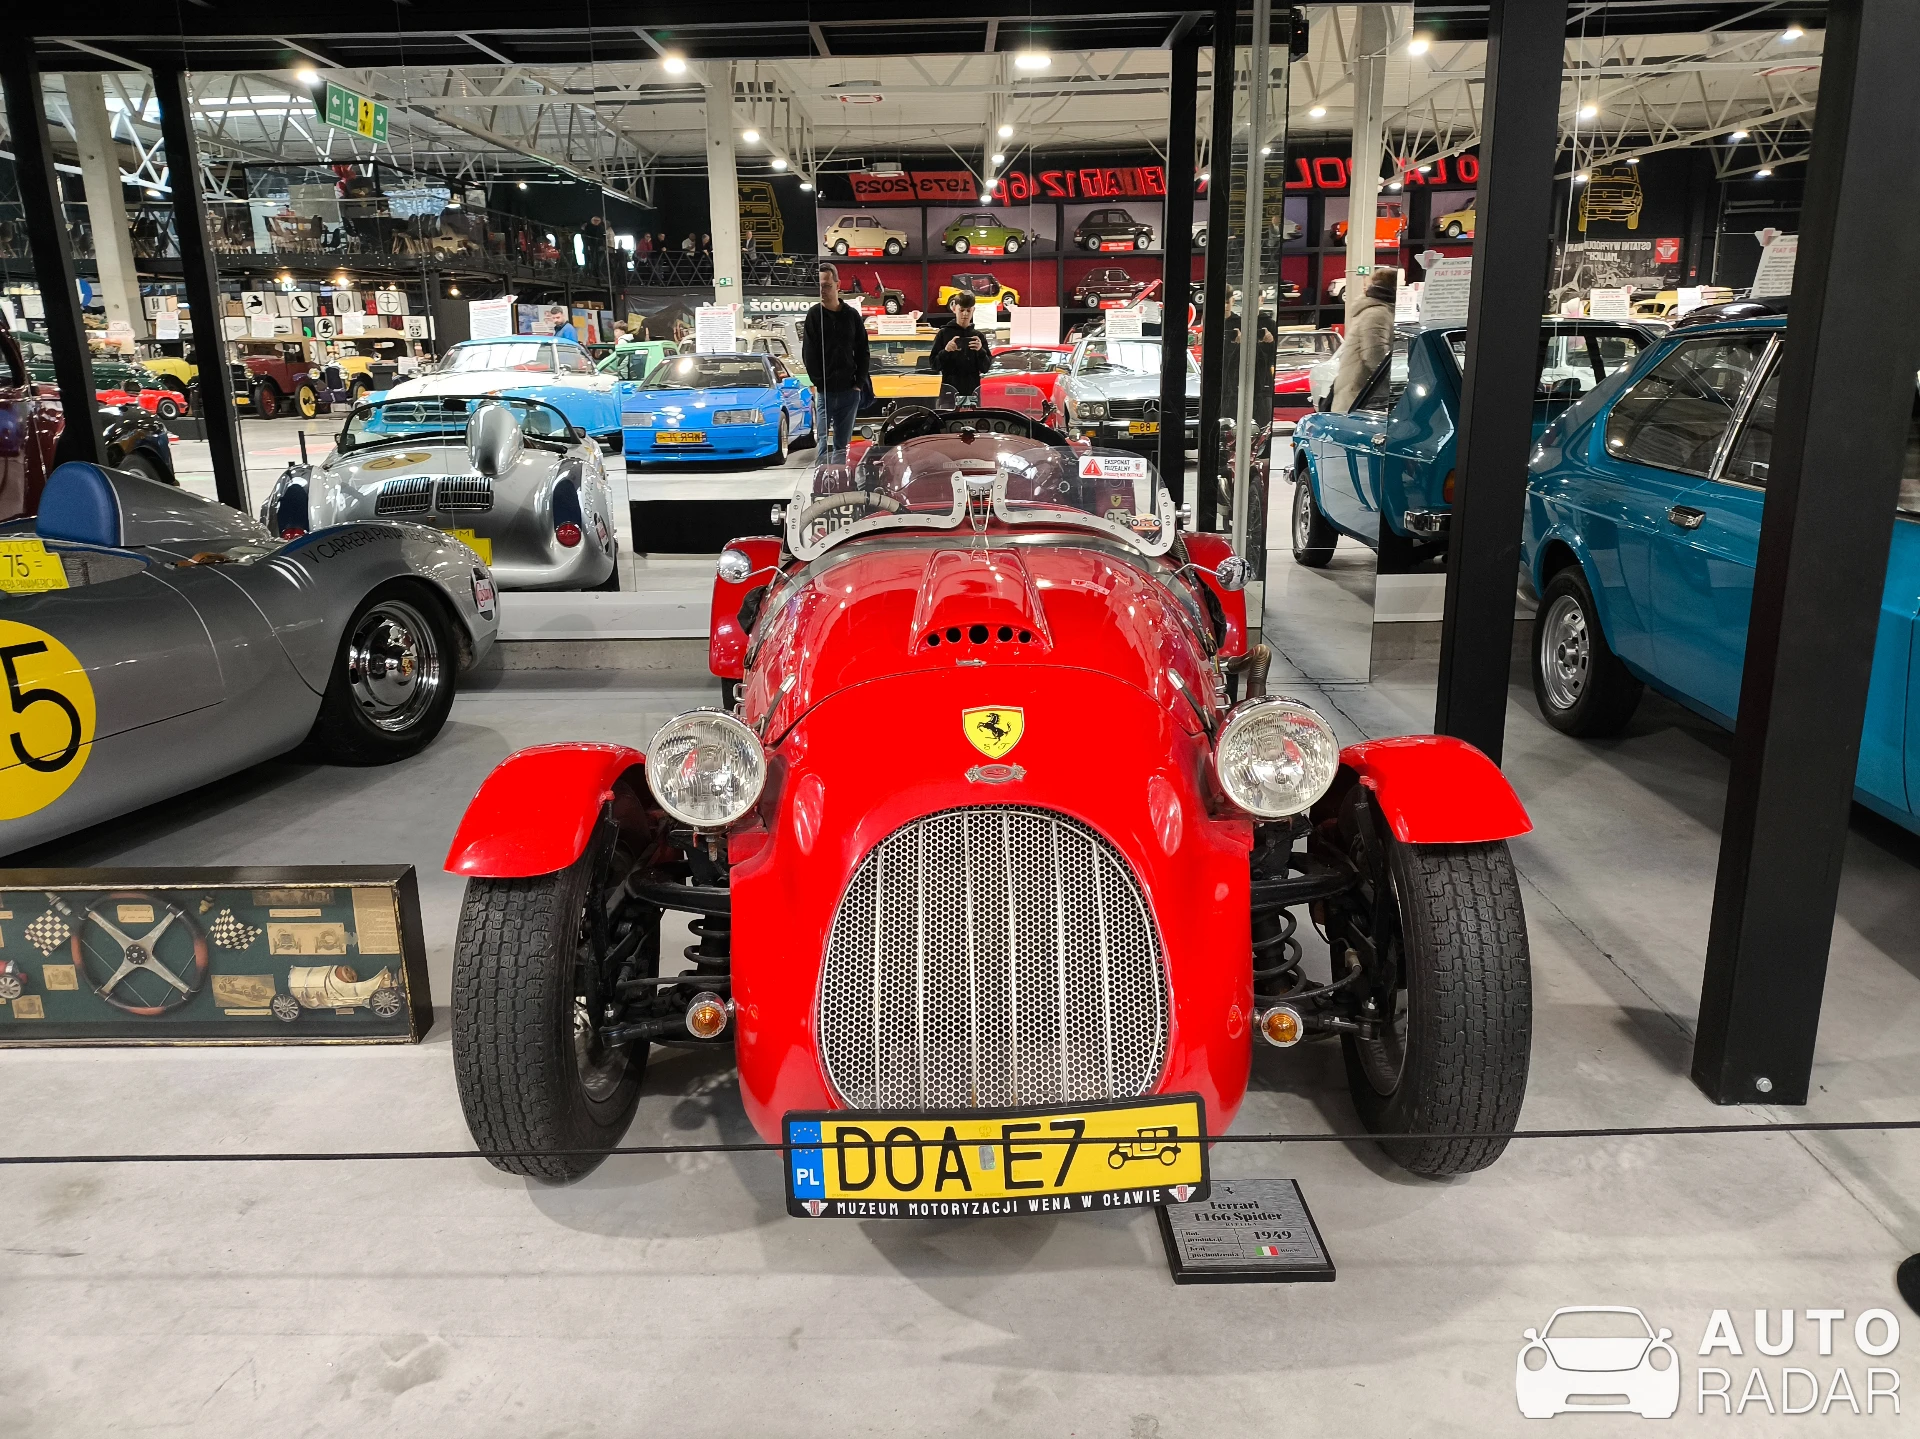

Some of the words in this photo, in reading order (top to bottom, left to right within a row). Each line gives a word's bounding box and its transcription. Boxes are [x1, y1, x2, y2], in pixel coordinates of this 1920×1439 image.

[317, 529, 376, 559] CARRERA
[836, 1126, 972, 1192] DOA
[1002, 1119, 1086, 1190] E7
[796, 1167, 820, 1186] PL
[837, 1202, 899, 1216] MUZEUM
[909, 1200, 1018, 1216] MOTORYZACJI
[1029, 1197, 1071, 1212] WENA
[1081, 1195, 1092, 1208] W
[1103, 1189, 1161, 1206] OŁAWIE
[1210, 1201, 1259, 1210] Ferrari
[1233, 1212, 1283, 1222] Spider
[1253, 1230, 1292, 1240] 1949
